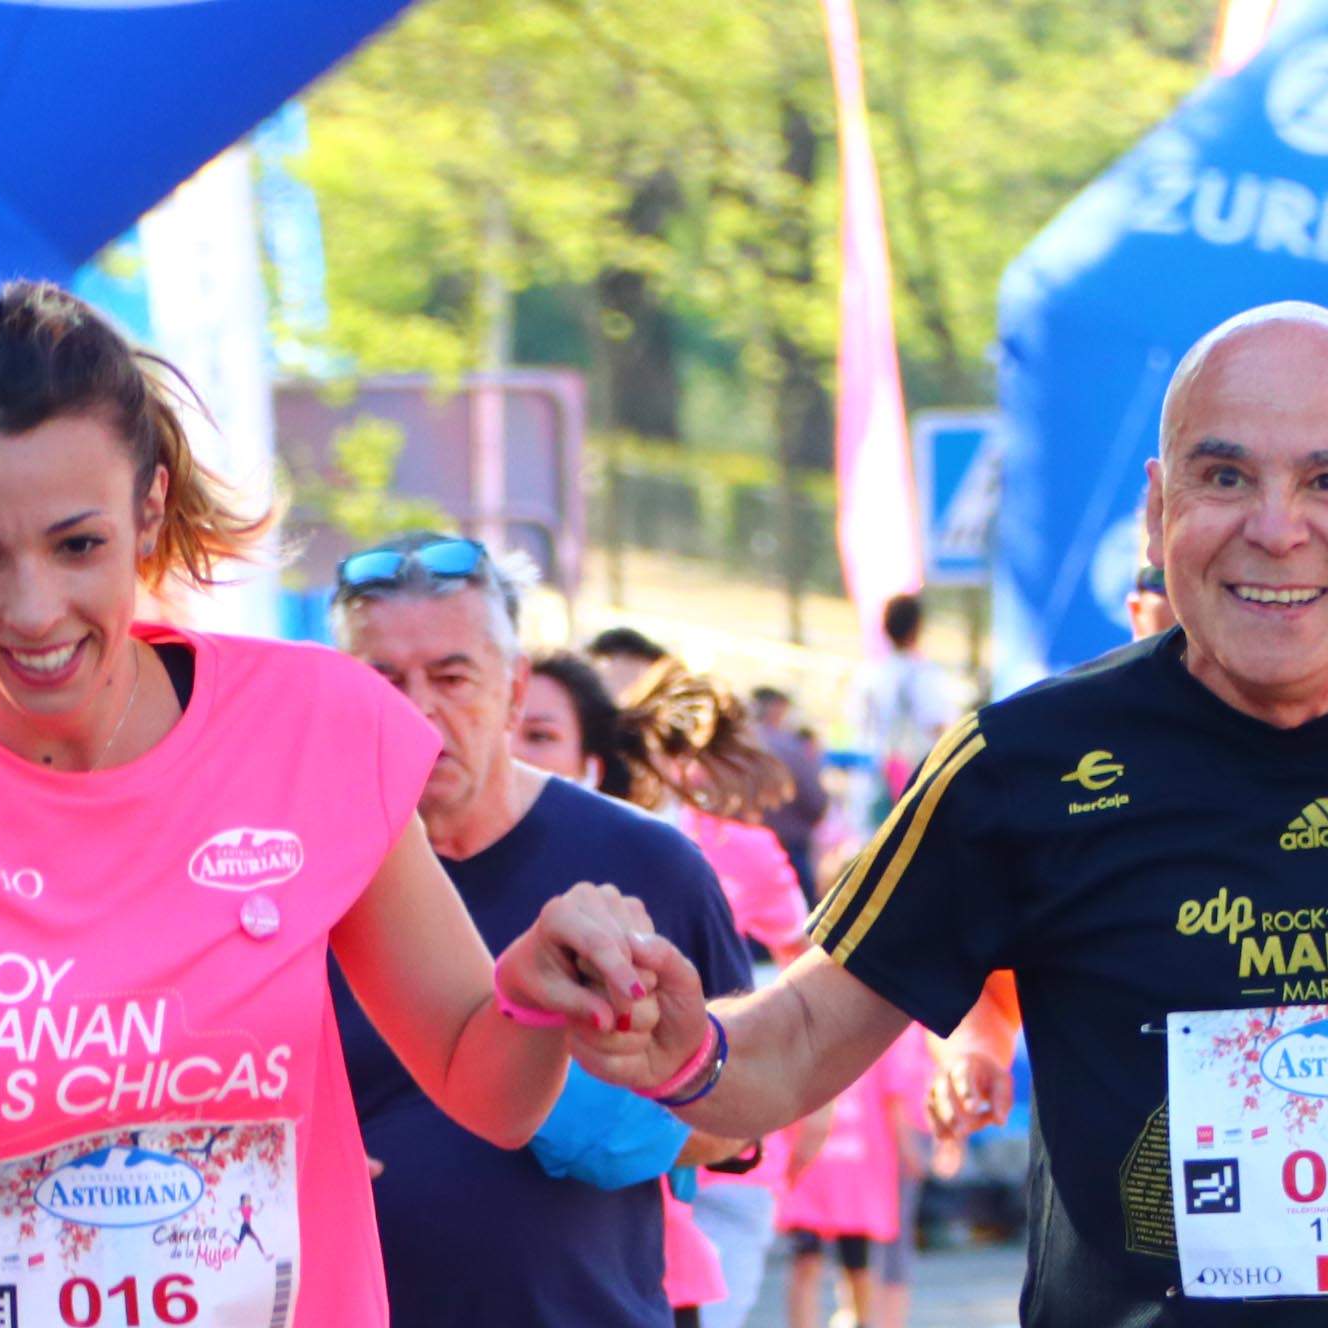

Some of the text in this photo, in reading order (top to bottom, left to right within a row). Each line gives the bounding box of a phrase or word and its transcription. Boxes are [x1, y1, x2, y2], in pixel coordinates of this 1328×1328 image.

[1176, 887, 1256, 945] edp
[56, 1045, 292, 1115] CHICAS
[49, 1180, 192, 1208] ASTURIANA
[153, 1224, 218, 1246] Carrera
[1201, 1265, 1282, 1286] OYSHO
[58, 1273, 199, 1328] 016
